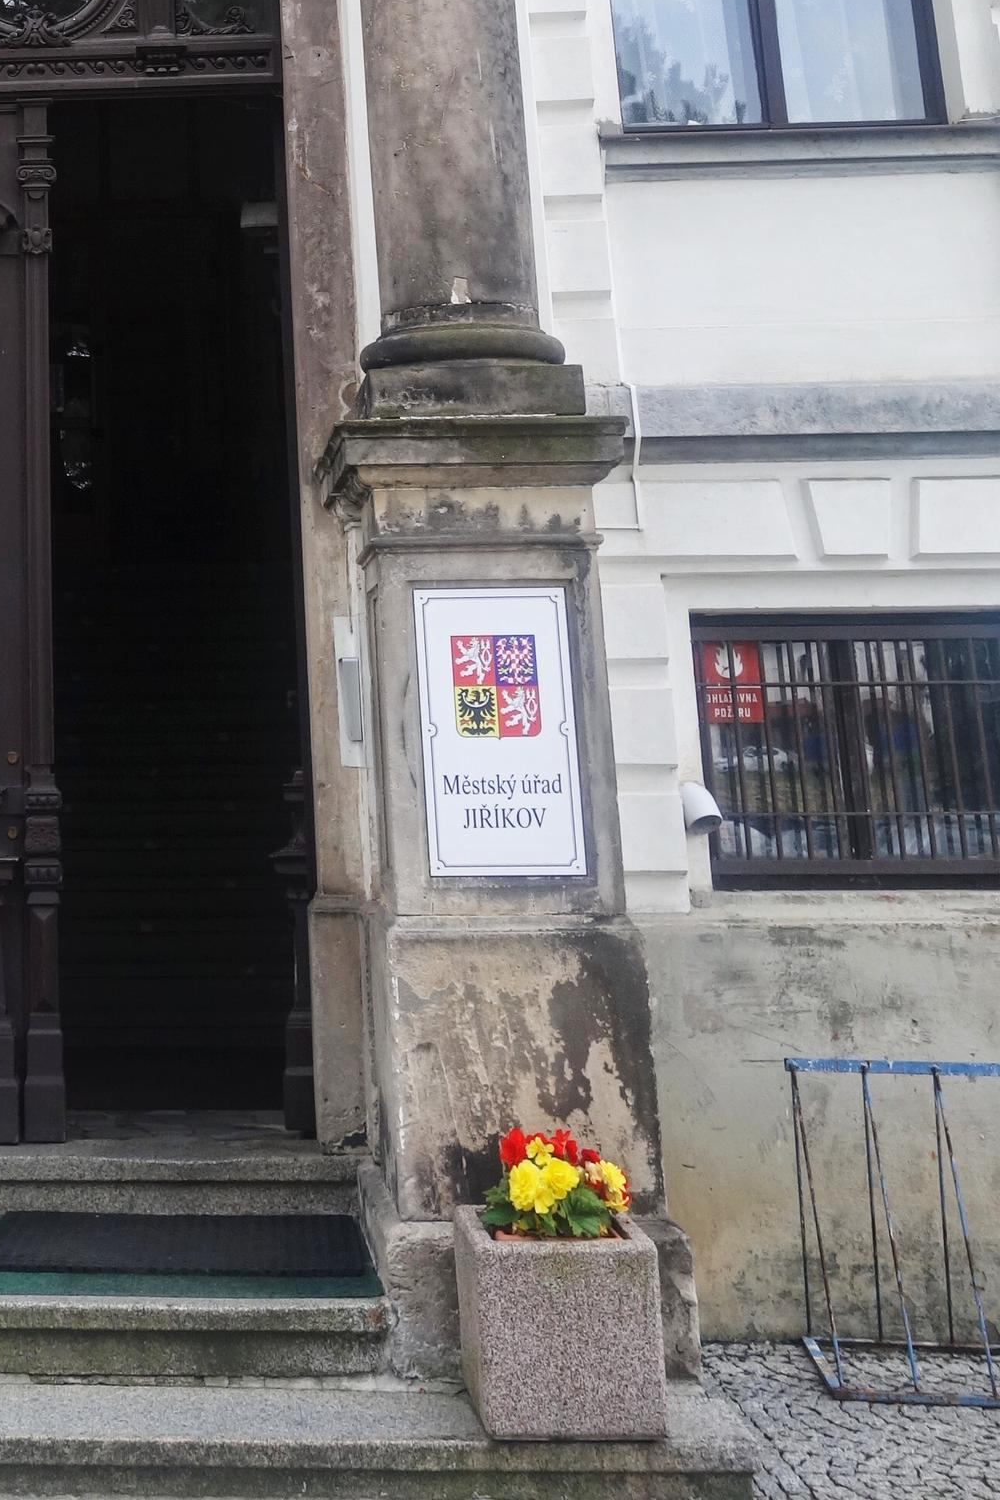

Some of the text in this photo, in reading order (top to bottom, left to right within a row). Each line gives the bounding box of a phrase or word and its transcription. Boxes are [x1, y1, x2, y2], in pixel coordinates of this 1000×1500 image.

[714, 705, 751, 718] POŽRU
[442, 773, 563, 800] Městský úřad
[463, 803, 547, 829] JIŘÍKOV
